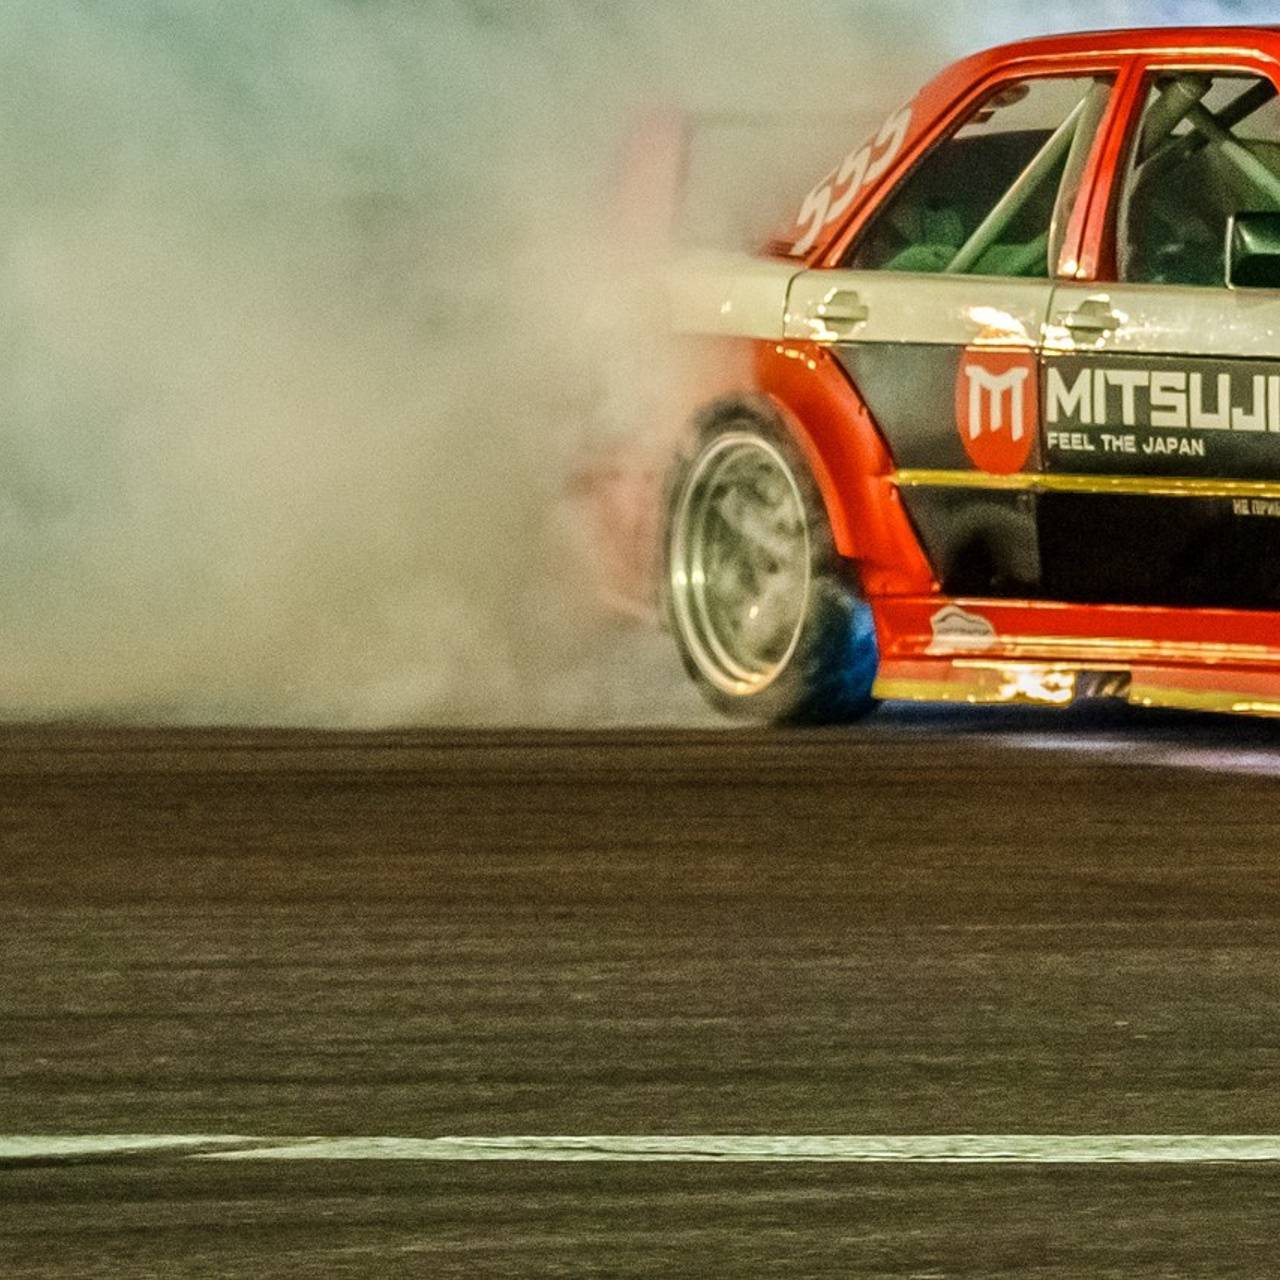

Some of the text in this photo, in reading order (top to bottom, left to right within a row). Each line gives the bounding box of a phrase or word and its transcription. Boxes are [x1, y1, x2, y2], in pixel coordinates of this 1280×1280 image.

[1047, 432, 1206, 456] FEEL THE JAPAN
